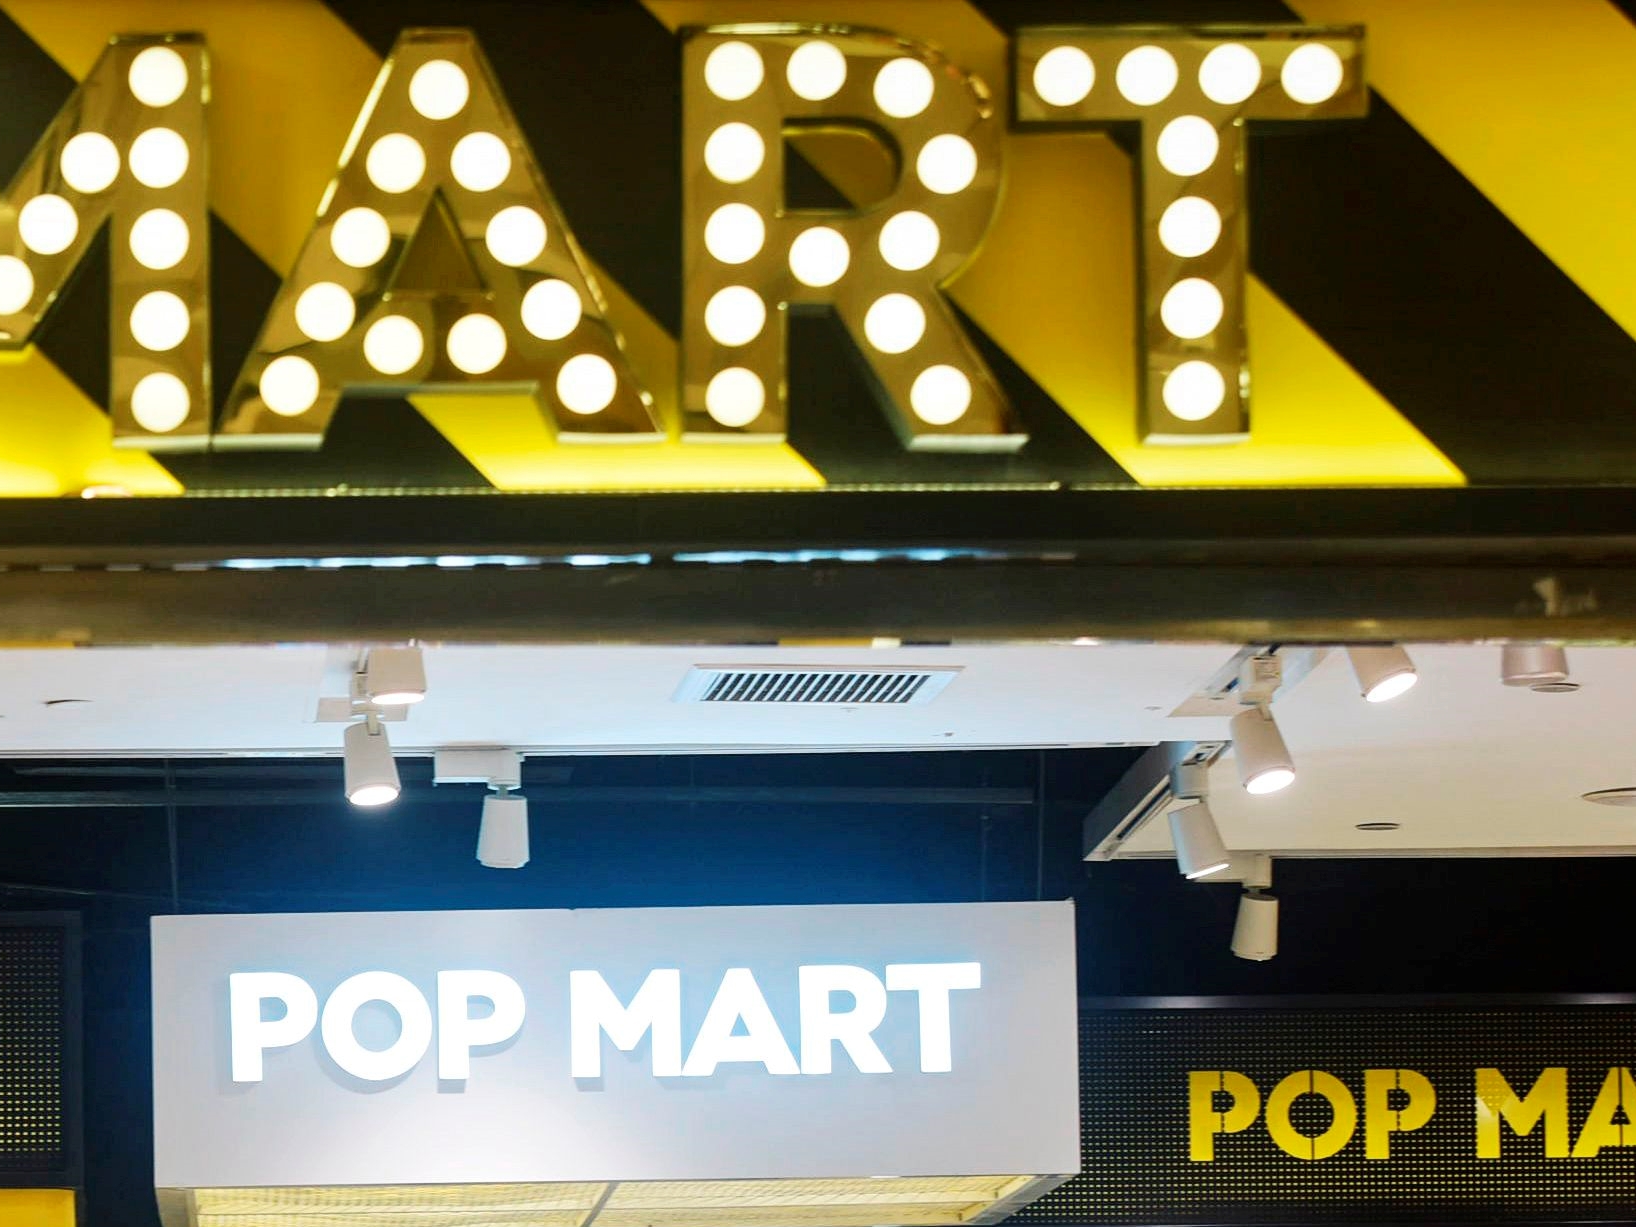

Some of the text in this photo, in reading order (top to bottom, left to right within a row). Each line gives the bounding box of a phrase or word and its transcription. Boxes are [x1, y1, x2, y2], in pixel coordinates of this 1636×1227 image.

[228, 961, 983, 1084] POP MART
[1187, 1069, 1438, 1162] POP
